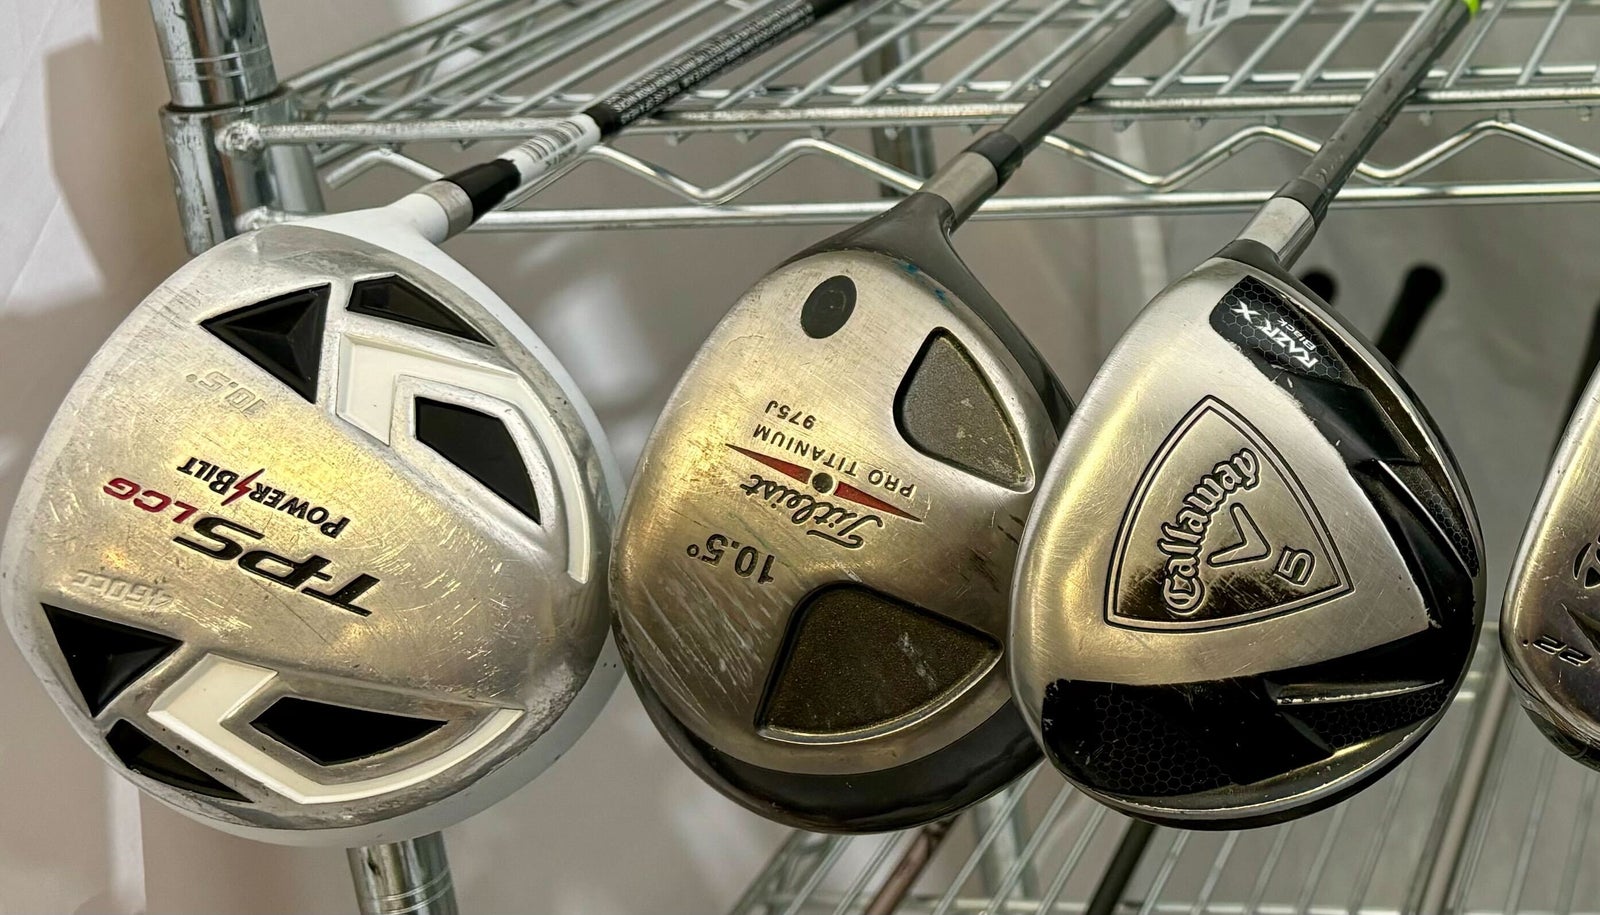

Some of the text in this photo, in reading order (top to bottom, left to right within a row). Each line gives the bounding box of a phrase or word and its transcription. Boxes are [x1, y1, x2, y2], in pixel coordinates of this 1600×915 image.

[1231, 300, 1319, 369] RAZR X
[1277, 317, 1317, 351] Black
[764, 400, 816, 430] 975J
[752, 423, 918, 500] PRO TITANIUM
[740, 473, 885, 550] Titleist
[1156, 447, 1261, 615] Callaway
[686, 533, 776, 585] 10.5°
[1273, 545, 1316, 587] 5
